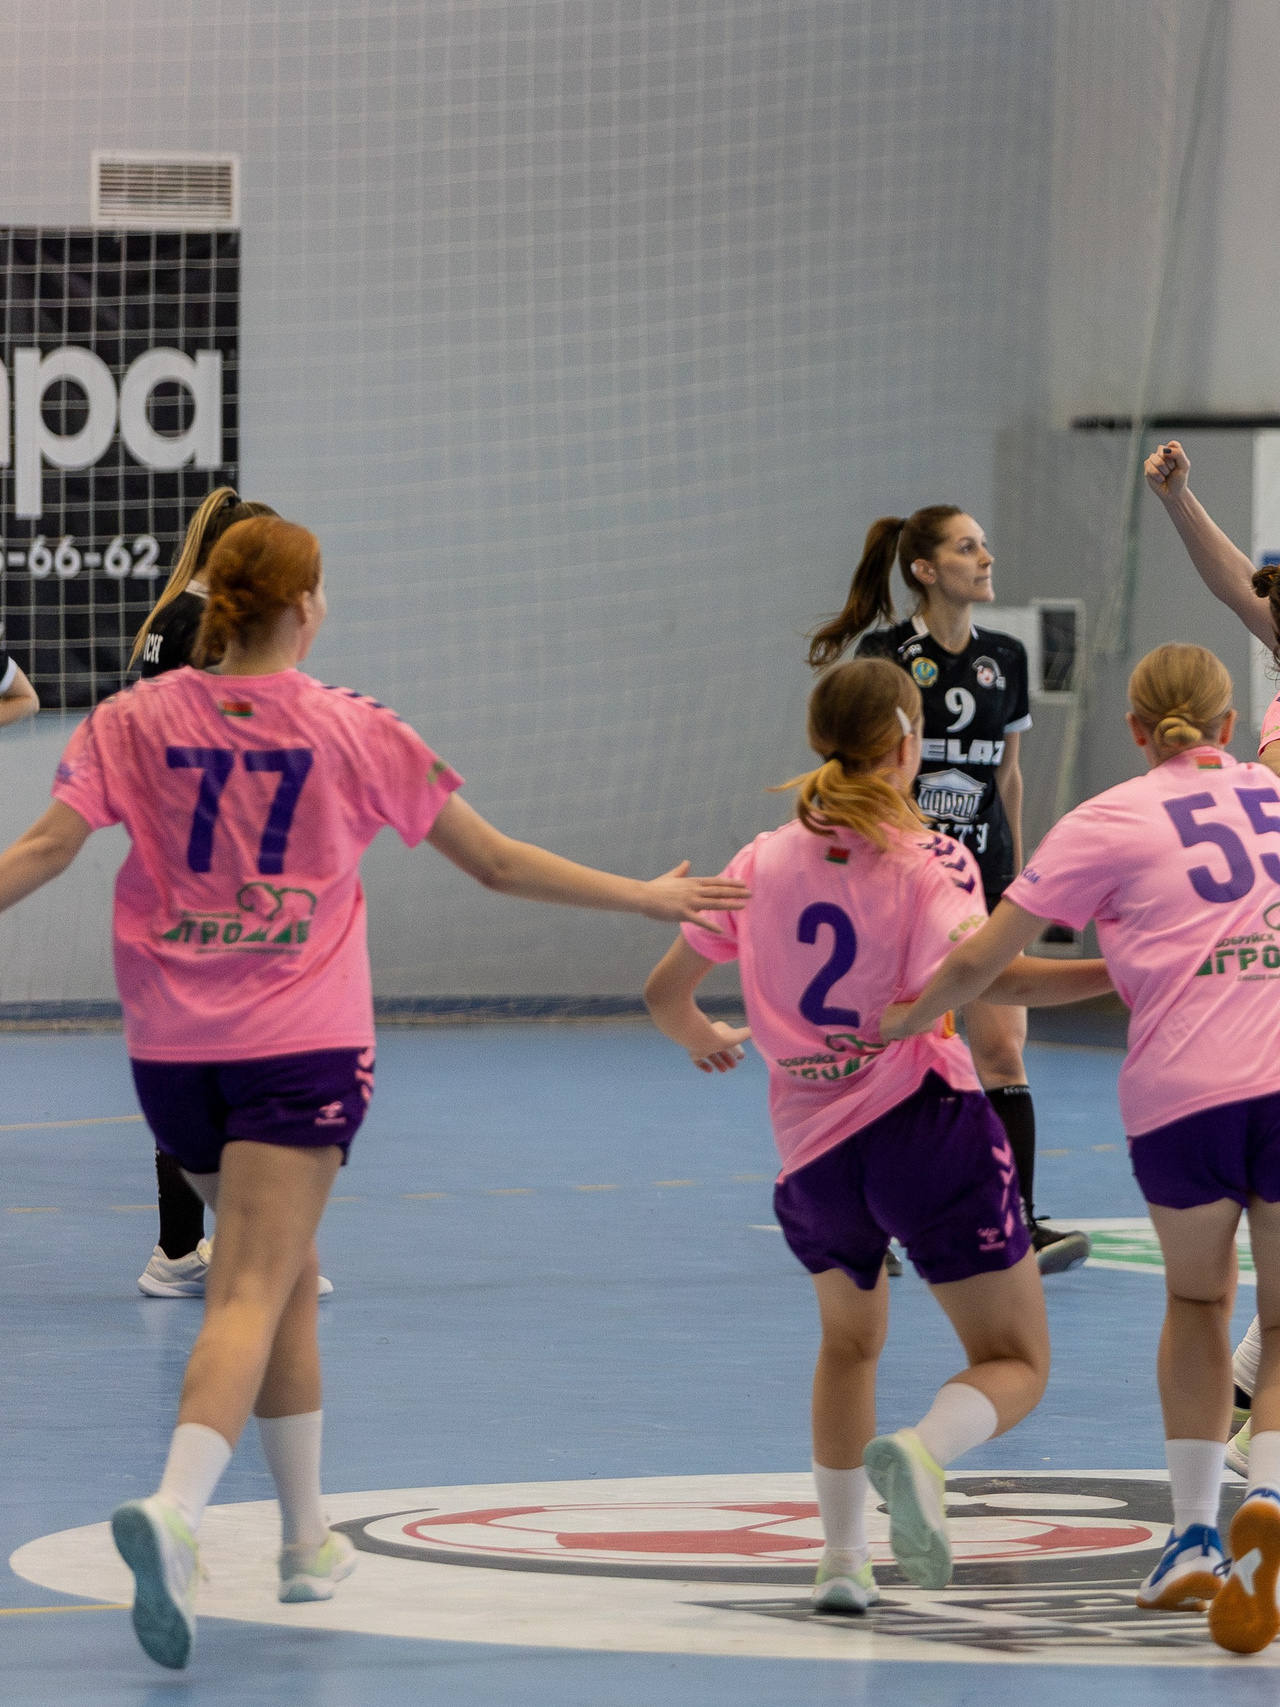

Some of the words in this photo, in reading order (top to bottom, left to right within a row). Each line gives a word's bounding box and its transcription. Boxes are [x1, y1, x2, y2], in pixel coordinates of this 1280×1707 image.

[0, 346, 223, 520] ра
[0, 534, 161, 580] -66-62
[922, 738, 1006, 766] ELAZ
[945, 687, 976, 733] 9
[166, 746, 314, 875] 77
[797, 901, 860, 1028] 2
